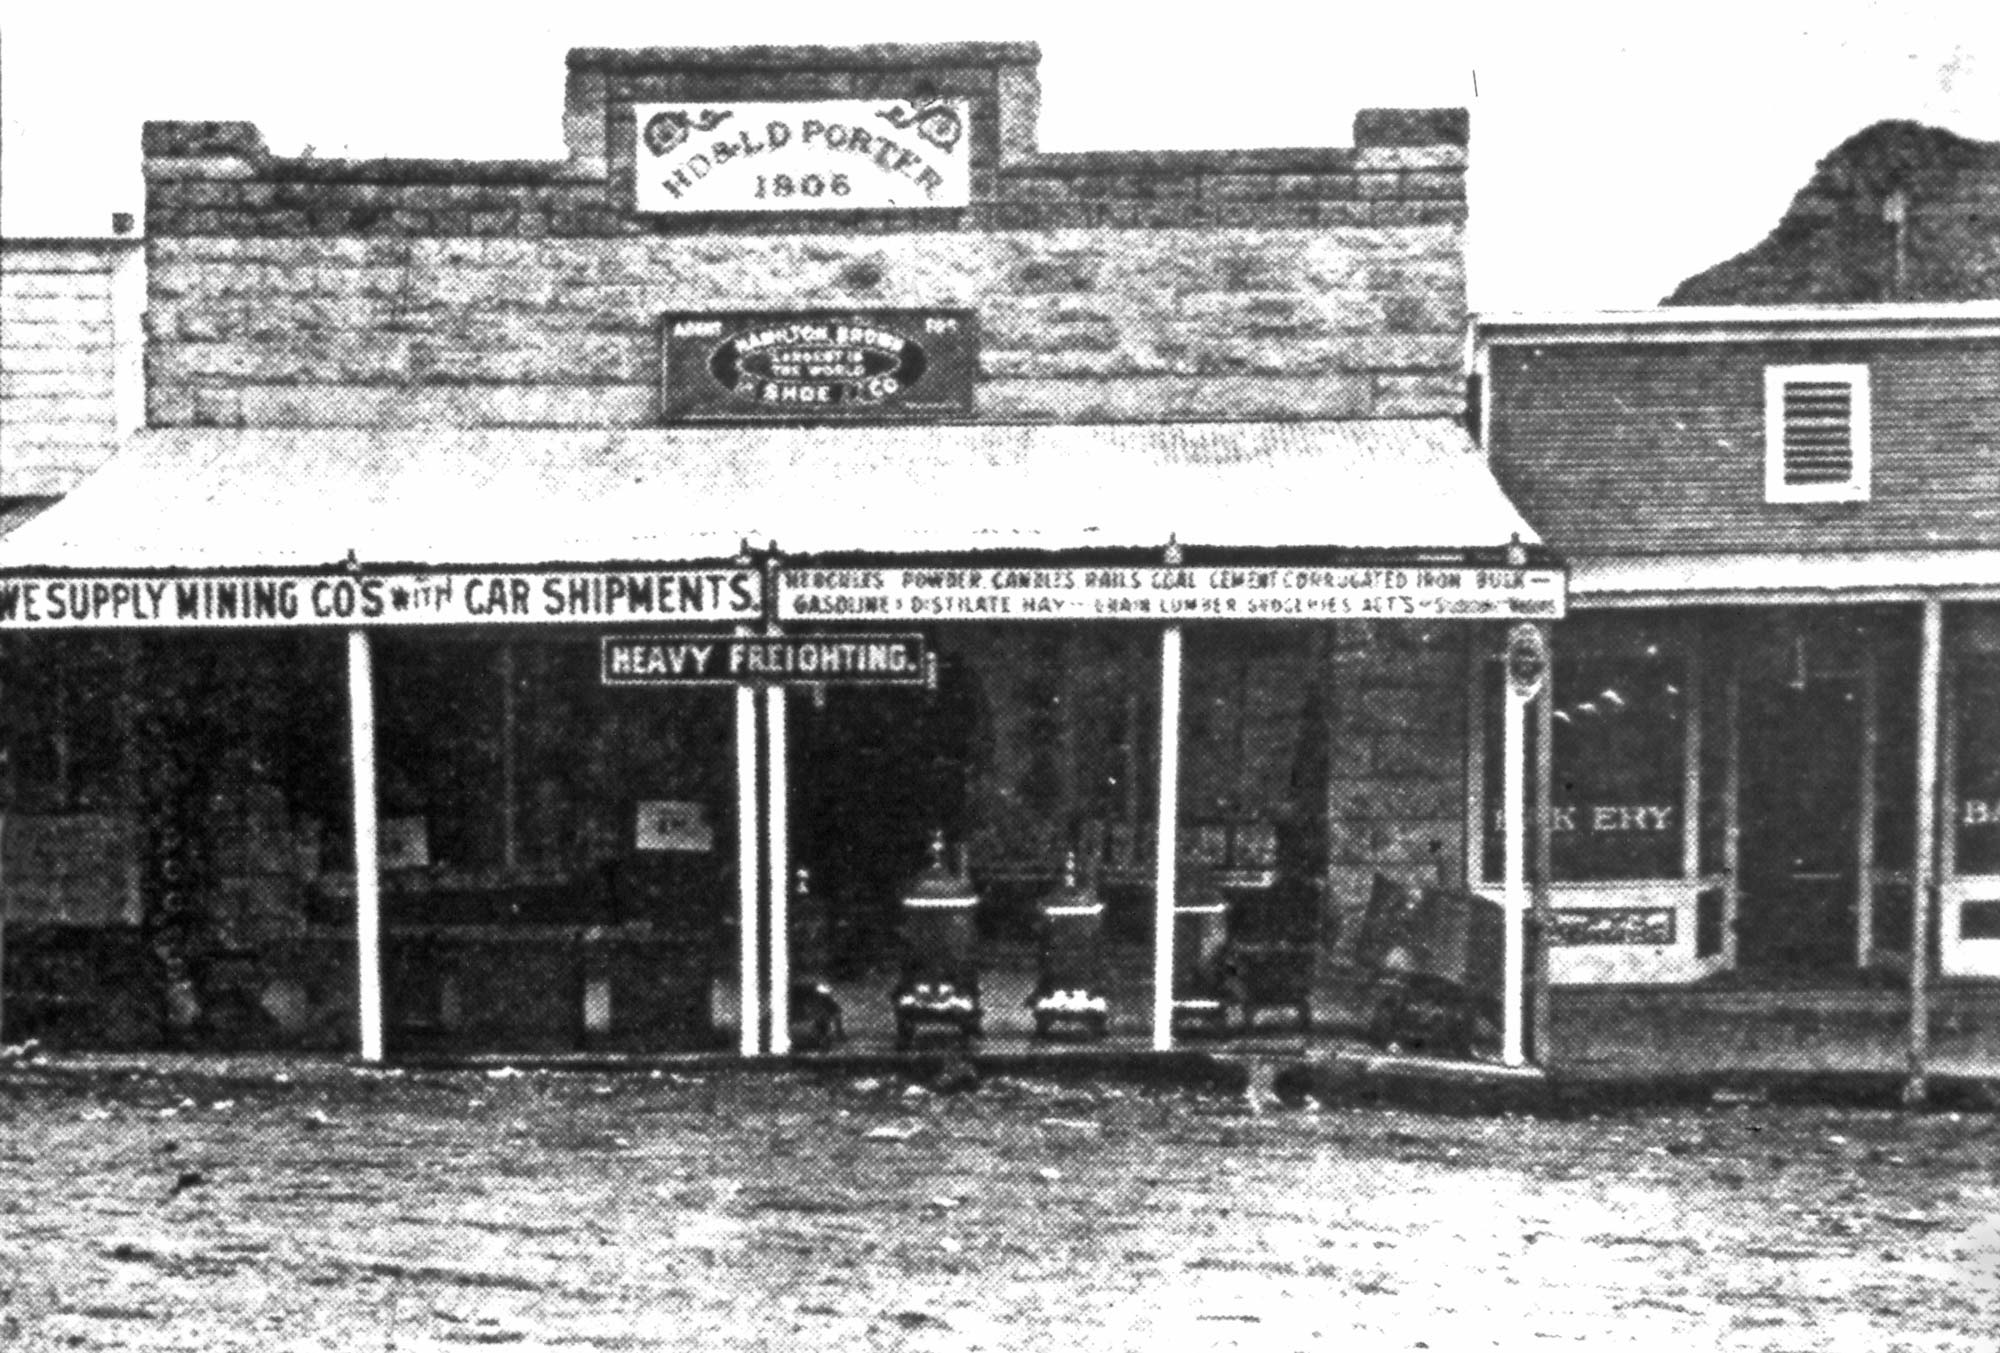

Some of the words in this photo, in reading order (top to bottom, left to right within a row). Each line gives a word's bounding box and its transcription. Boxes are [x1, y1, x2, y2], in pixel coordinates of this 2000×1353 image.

[802, 119, 944, 200] PORTER
[836, 322, 905, 352] BROWN
[763, 382, 830, 402] SHOE
[901, 570, 982, 590] POWDER
[1084, 570, 1142, 590] RAILS
[1150, 570, 1196, 590] COAL
[1209, 570, 1278, 590] CEMENT
[1282, 569, 1408, 590] CORRUGATED
[1416, 570, 1462, 590] IRON
[0, 581, 41, 622] WE
[46, 580, 166, 620] SUPPLY
[175, 581, 298, 620] MINING
[390, 576, 453, 612] WITH
[464, 576, 531, 616] CAR
[1022, 596, 1065, 612] HAY
[1159, 597, 1236, 614] LUMBER
[611, 644, 713, 674] HEAVY
